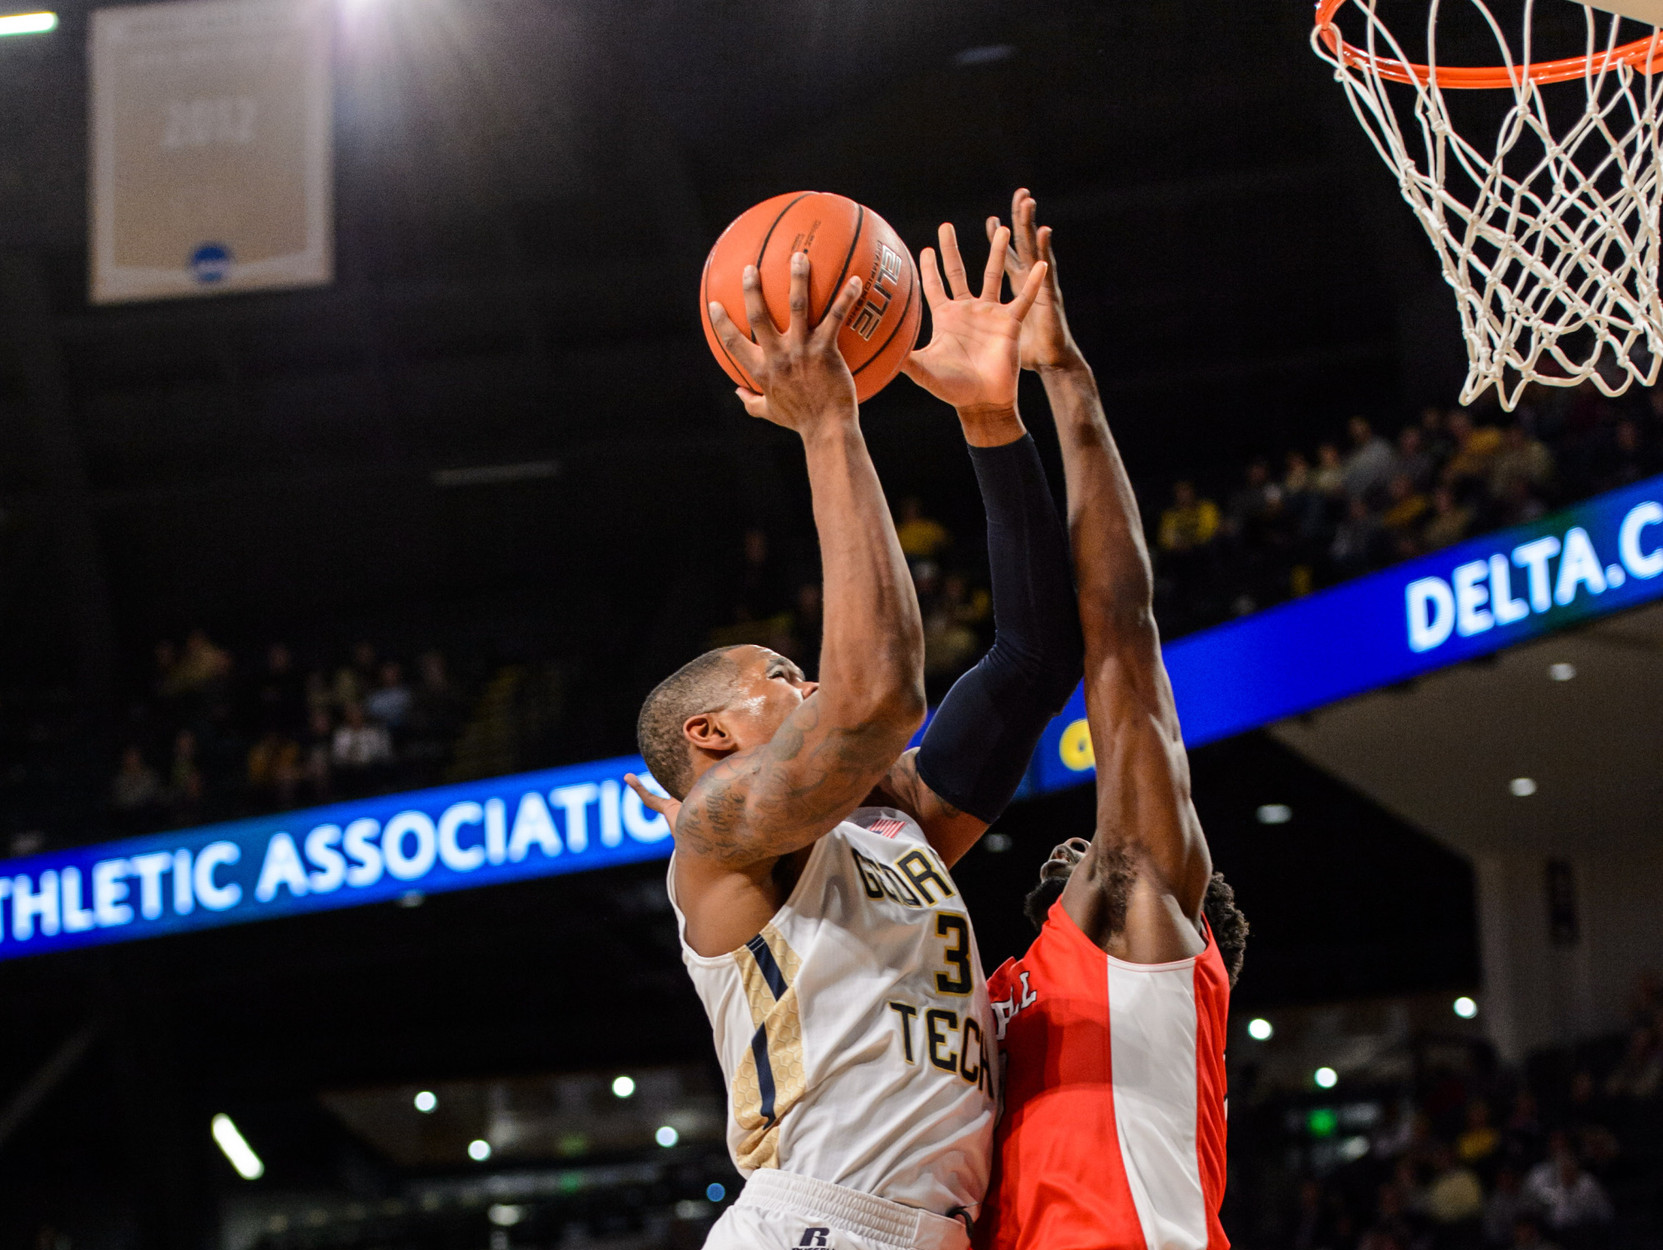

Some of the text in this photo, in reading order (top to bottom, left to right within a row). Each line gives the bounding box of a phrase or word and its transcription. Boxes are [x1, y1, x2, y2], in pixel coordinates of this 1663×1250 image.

[934, 911, 973, 998] 3
[889, 1001, 994, 1100] TECH
[799, 1227, 830, 1247] R
